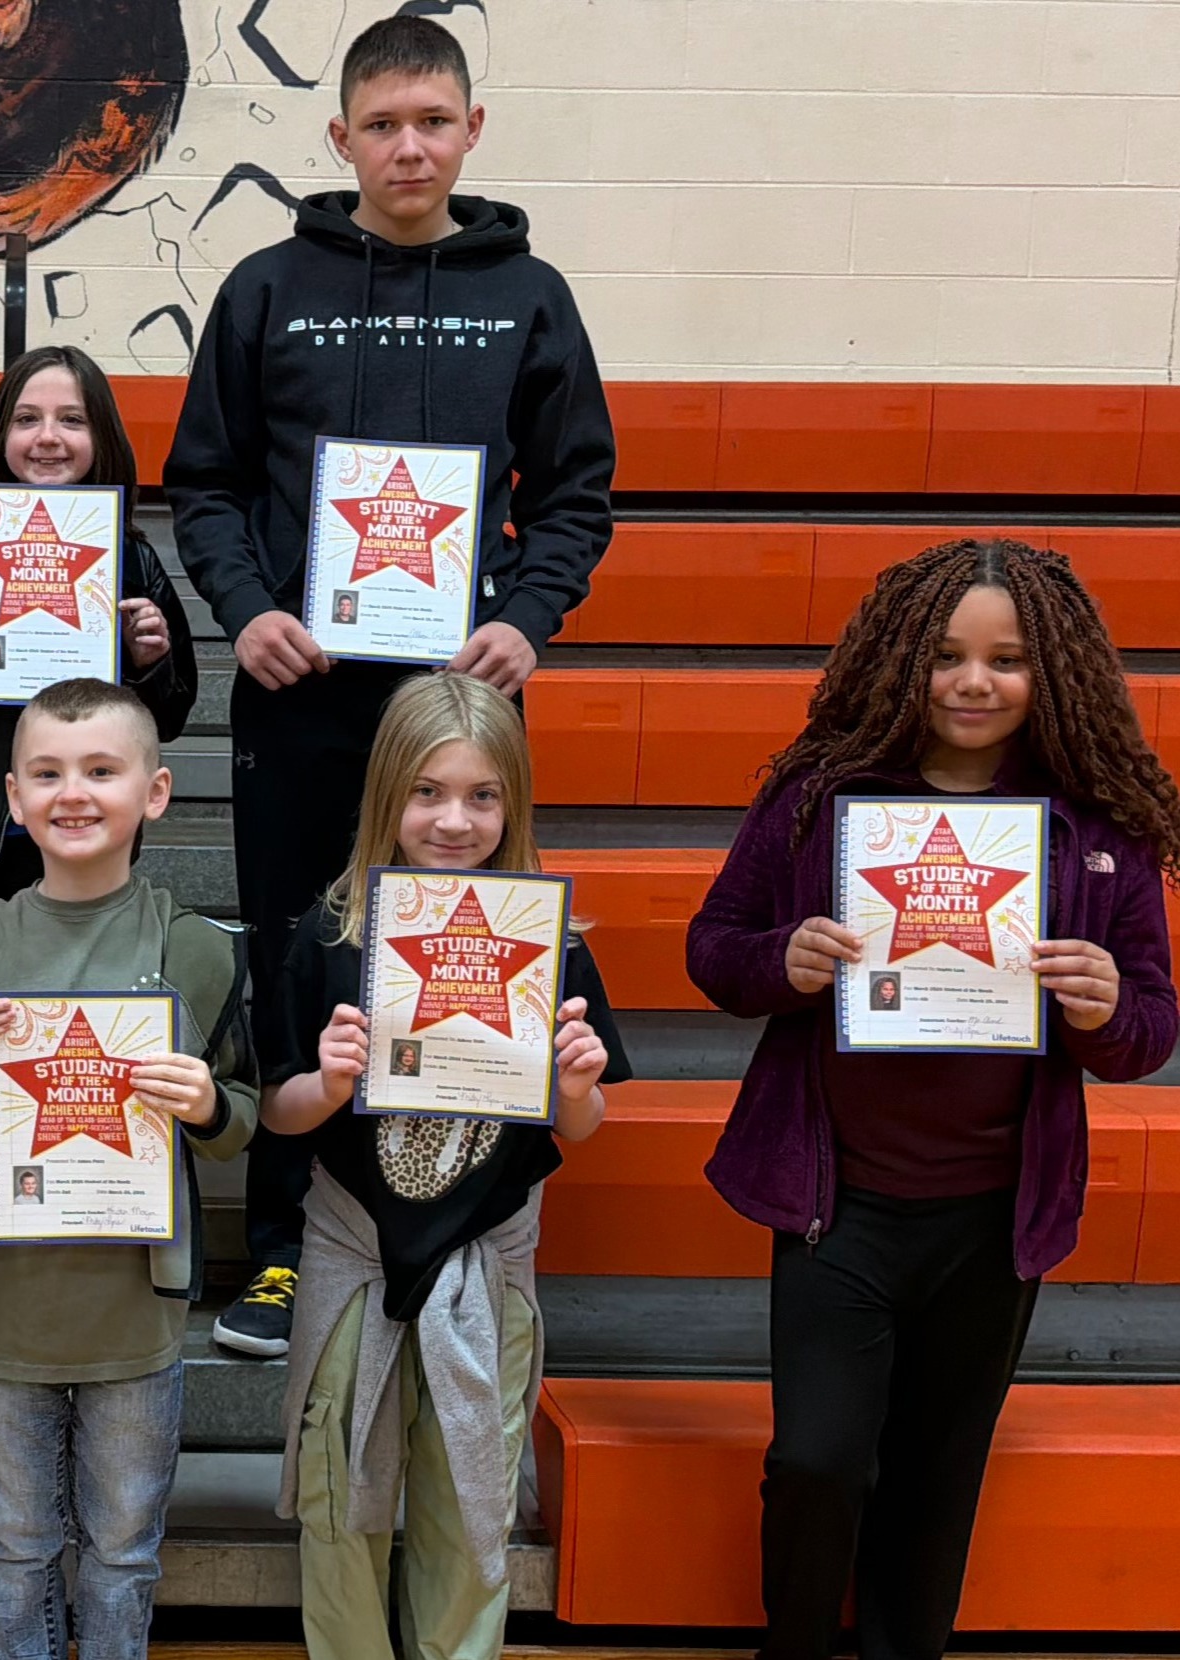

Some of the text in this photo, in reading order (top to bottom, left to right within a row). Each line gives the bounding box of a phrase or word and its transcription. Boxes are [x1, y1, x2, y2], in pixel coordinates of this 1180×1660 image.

[287, 316, 516, 332] BLANKENSHIP
[315, 334, 488, 347] DEAILING
[386, 481, 412, 490] BRIGHT
[379, 489, 416, 499] AWESOME
[359, 500, 439, 519] STUDENT
[379, 514, 414, 524] OF THE
[27, 524, 52, 532] BRIGHT
[366, 523, 425, 539] MONTH
[21, 533, 57, 541] AWESOME
[361, 538, 428, 551] ACHIEVEMENT
[1, 543, 80, 560] STUDENT
[22, 558, 56, 566] OF THE
[10, 567, 68, 581] MONTH
[5, 582, 71, 593] ACHIEVEMENT
[926, 843, 958, 853] BRIGHT
[918, 854, 964, 864] AWESOME
[893, 866, 994, 886] STUDENT
[920, 883, 964, 893] OF THE
[905, 894, 978, 911] MONTH
[453, 915, 484, 925] BRIGHT
[899, 912, 982, 924] ACHIEVEMENT
[445, 925, 488, 935] AWESOME
[421, 936, 516, 958] STUDENT
[894, 940, 920, 949] SHINE
[958, 941, 989, 951] SWEET
[445, 953, 487, 964] OF THE
[430, 964, 500, 982] MONTH
[424, 981, 503, 995] ACHIEVEMENT
[418, 1009, 442, 1018] SHINE
[479, 1012, 507, 1022] SWEET
[64, 1037, 95, 1047] BRIGHT
[992, 1033, 1031, 1043] Lifetouch
[57, 1047, 100, 1057] AWESOME
[33, 1059, 129, 1079] STUDENT
[59, 1075, 101, 1086] OF THE
[45, 1086, 115, 1103] MONTH
[41, 1104, 119, 1116] ACHIEVEMENT
[503, 1103, 541, 1113] Lifetouch
[37, 1132, 61, 1141] SHINE
[98, 1132, 126, 1141] SWEET
[130, 1224, 167, 1233] Lifetouch
